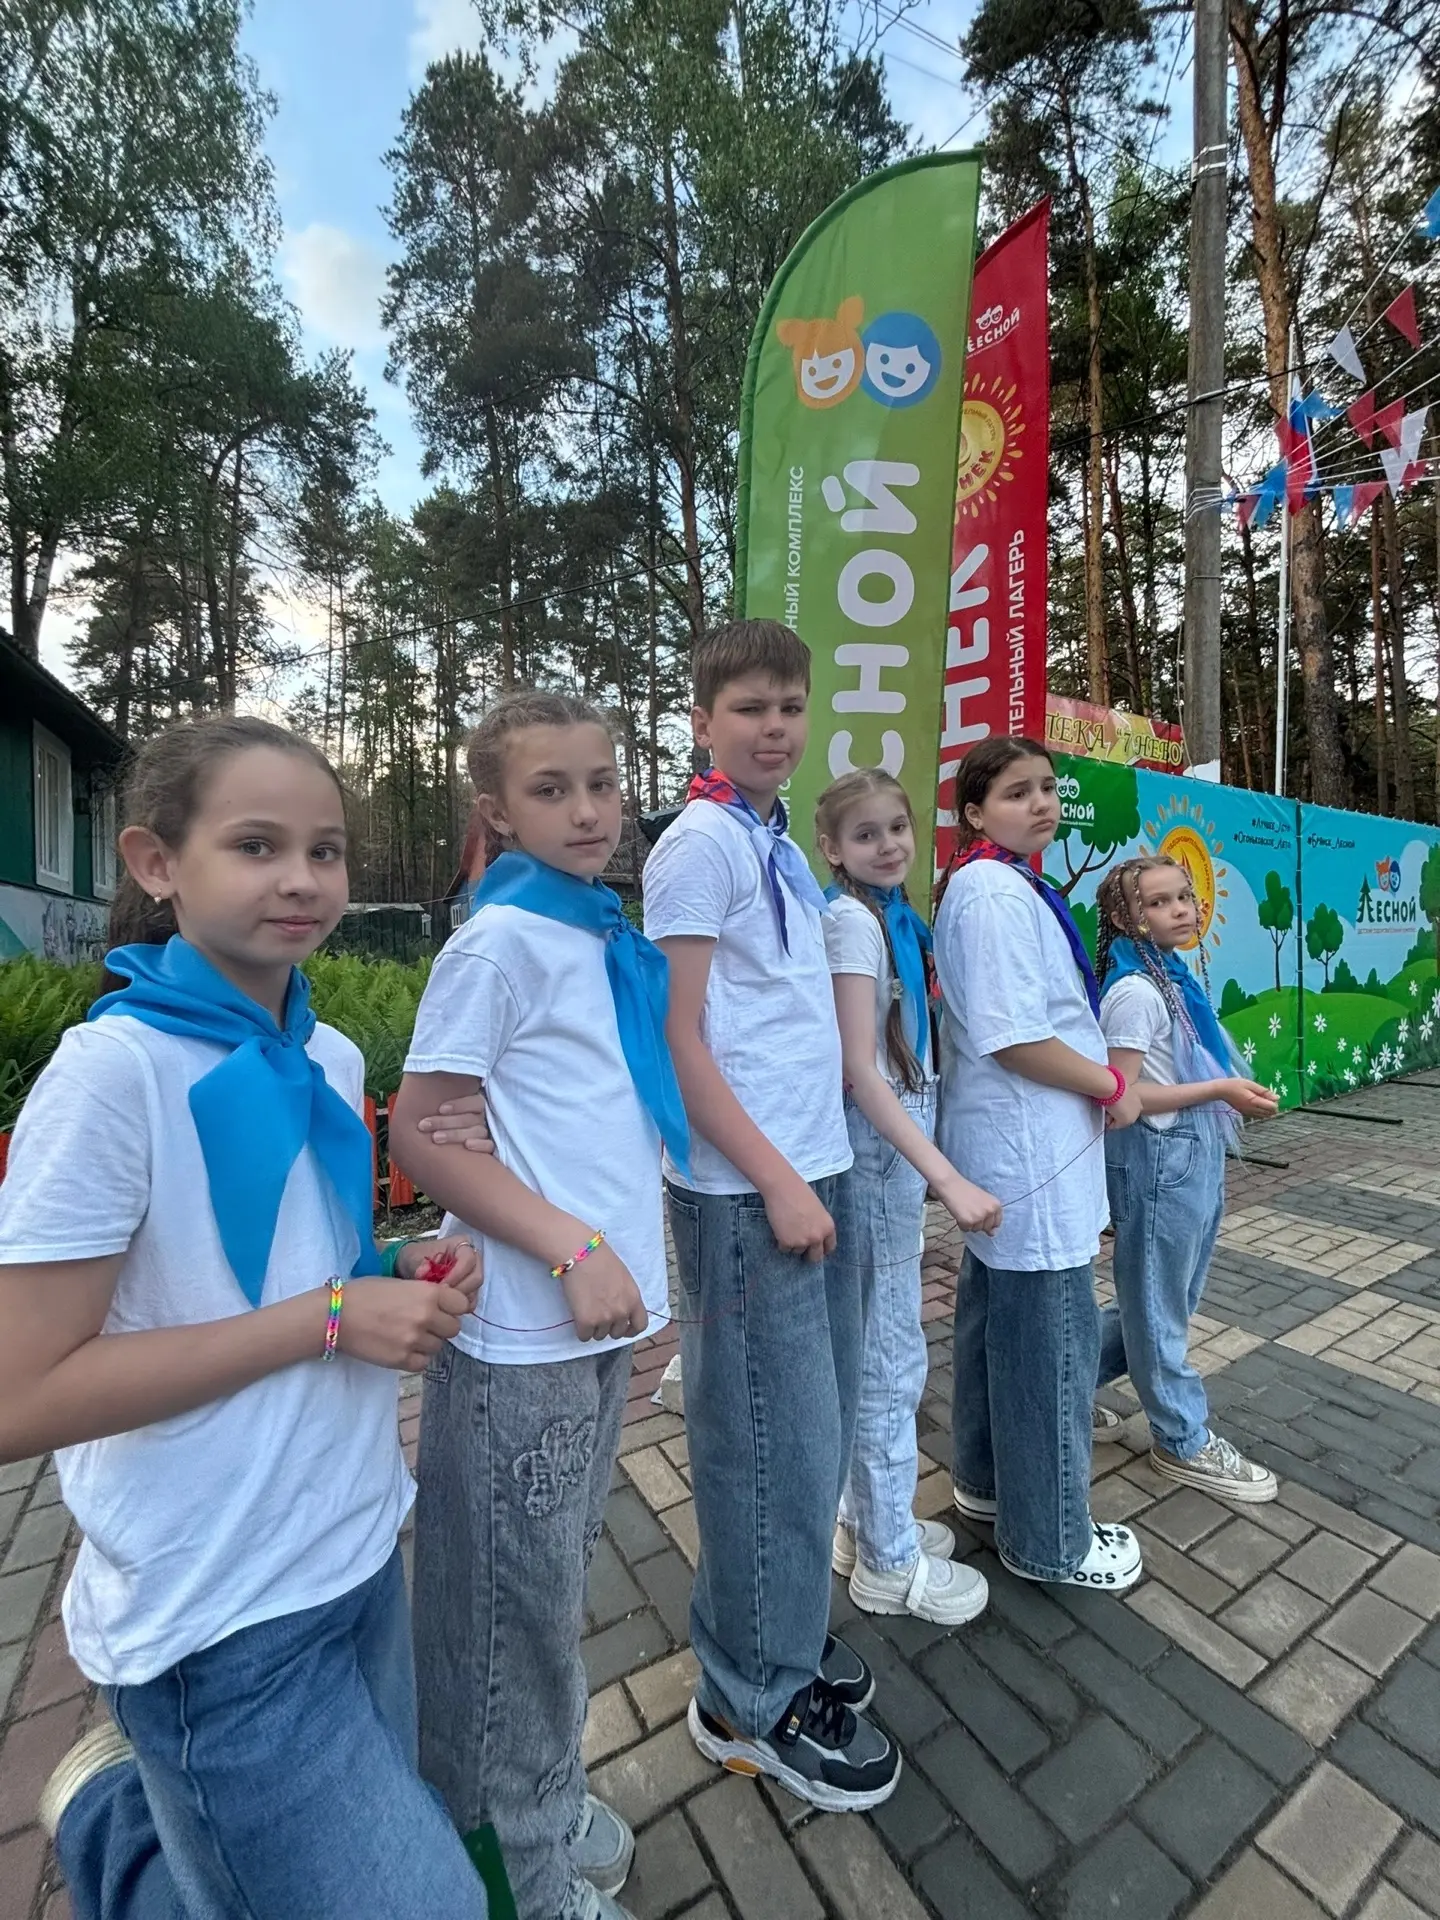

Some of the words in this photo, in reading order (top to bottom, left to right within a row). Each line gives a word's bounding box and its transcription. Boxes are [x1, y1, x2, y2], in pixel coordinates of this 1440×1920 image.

[959, 450, 995, 490] НЁК
[787, 466, 804, 577] КОМПЛЕКС
[1008, 529, 1025, 618] ЛАГЕРЬ
[784, 584, 801, 634] НЫЙ
[821, 460, 920, 779] СНОЙ
[1006, 625, 1025, 739] ТЕЛЬНЫЙ
[1046, 713, 1106, 751] ТЕКА
[1061, 802, 1095, 820] СНОЙ
[1074, 1571, 1116, 1584] OCS
